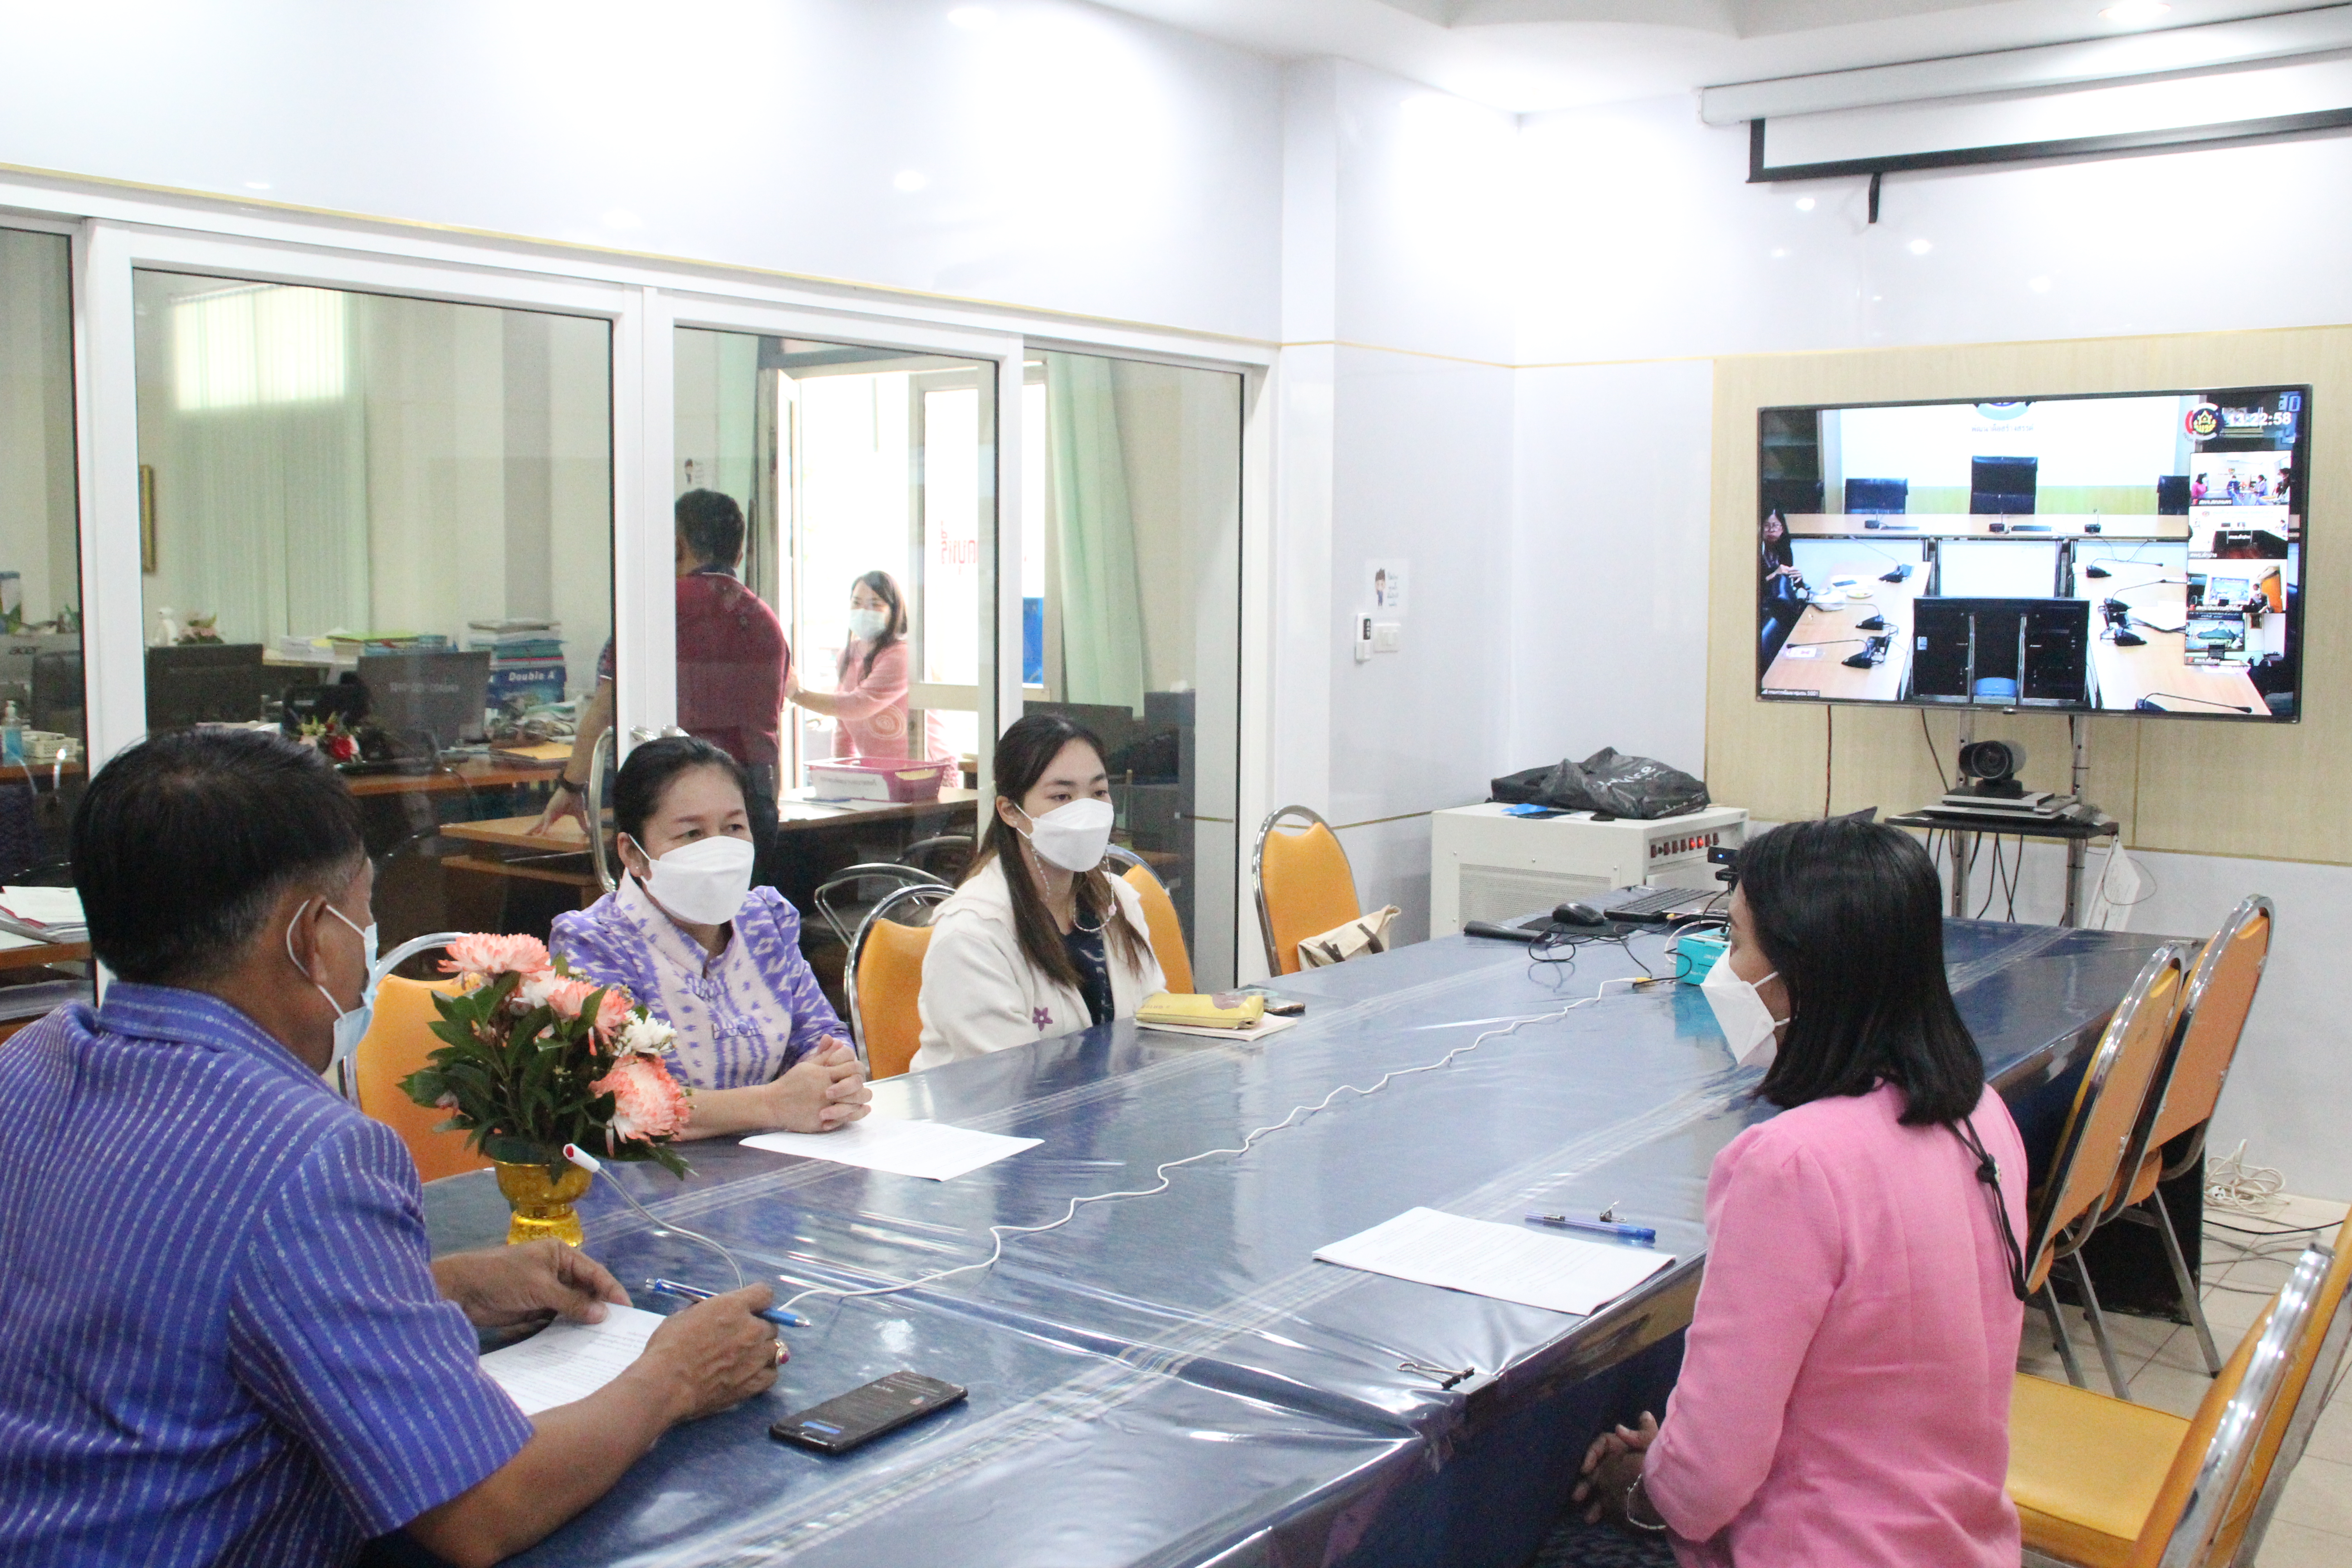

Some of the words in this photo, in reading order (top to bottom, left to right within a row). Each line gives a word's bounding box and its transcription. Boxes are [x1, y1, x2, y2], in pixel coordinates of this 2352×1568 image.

[2227, 412, 2292, 426] 13:22:58
[509, 671, 544, 681] Double
[547, 670, 555, 680] A
